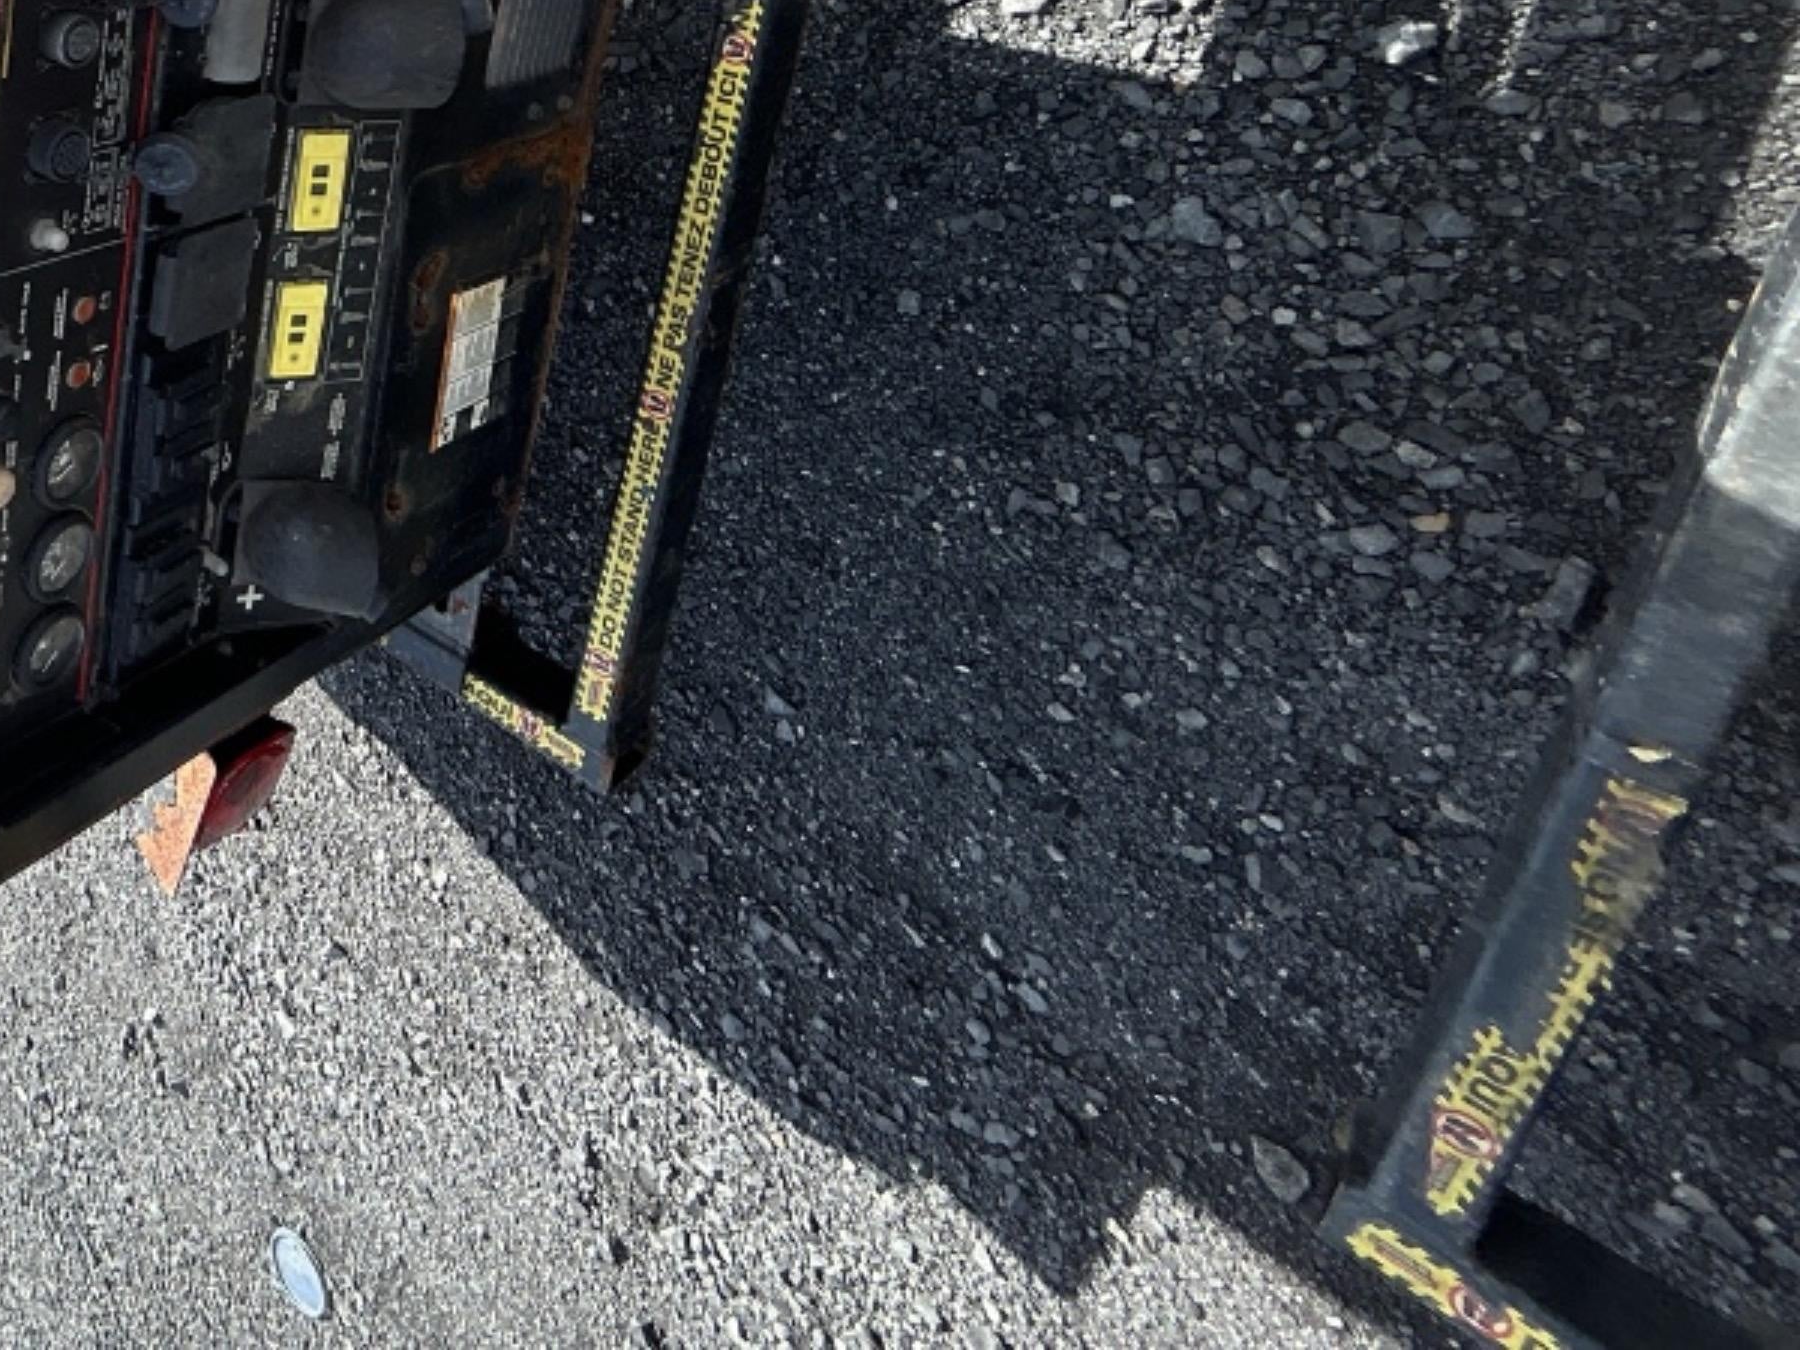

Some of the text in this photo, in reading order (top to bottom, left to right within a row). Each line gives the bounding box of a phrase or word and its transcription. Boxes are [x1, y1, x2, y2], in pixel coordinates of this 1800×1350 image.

[655, 68, 739, 390] NE PAS TENEZ DEBOUT ICI
[615, 484, 651, 564] STAND
[604, 568, 630, 613] NOT
[598, 616, 617, 651] DO
